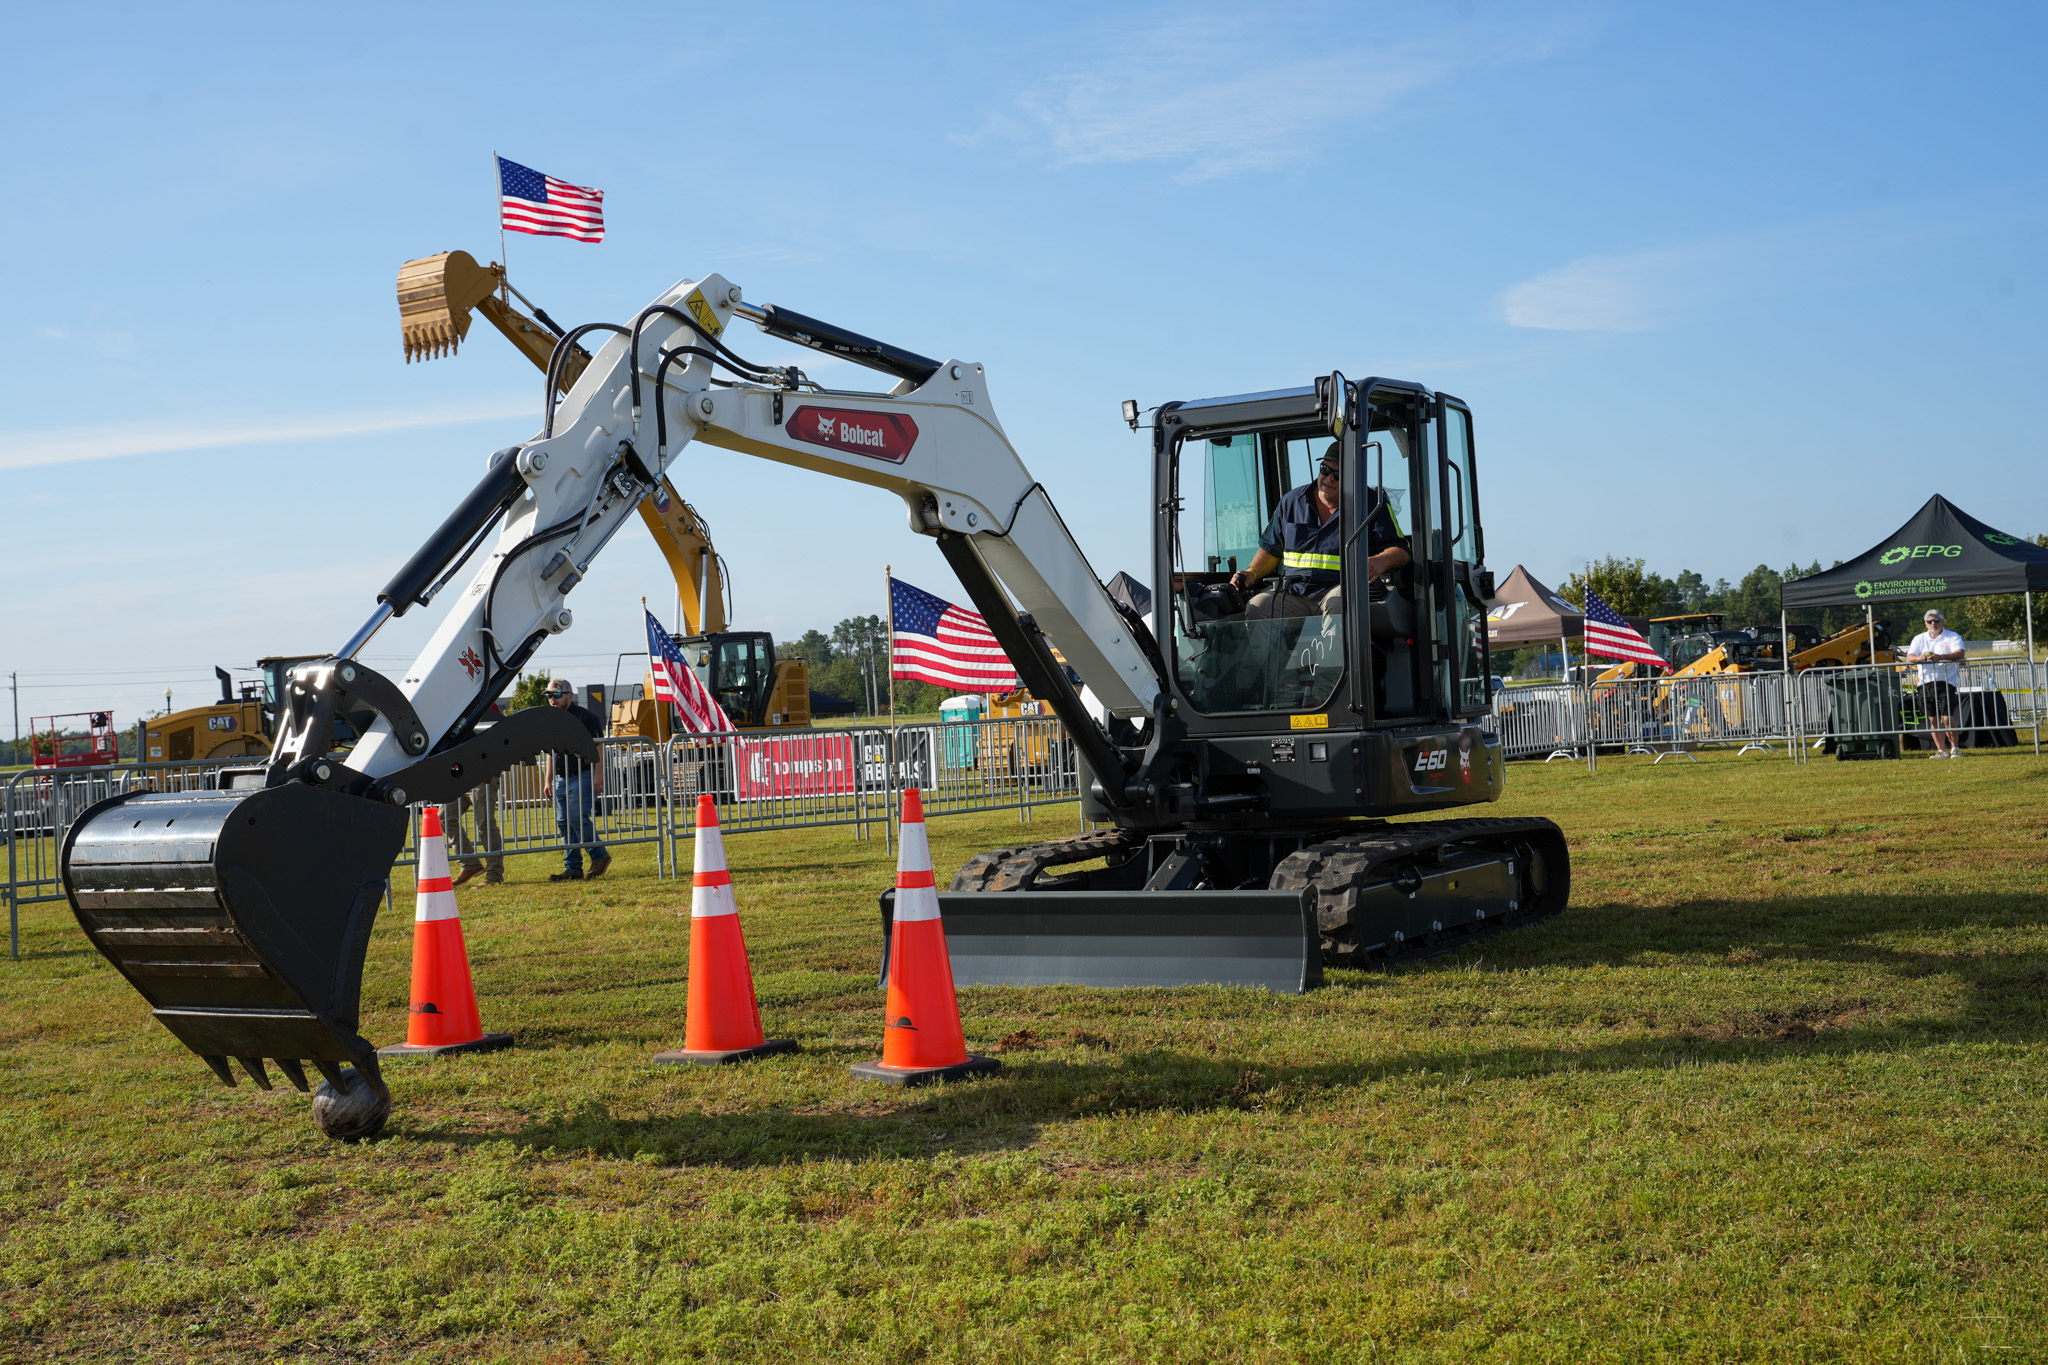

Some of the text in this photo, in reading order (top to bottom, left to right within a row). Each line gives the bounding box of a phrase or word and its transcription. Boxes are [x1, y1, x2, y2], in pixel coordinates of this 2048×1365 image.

[840, 422, 884, 447] Bobcat
[1911, 545, 1962, 558] EPG
[1874, 578, 1947, 590] ENVIRONMENTAL
[1874, 585, 1947, 596] PRODUCTS GROUP
[1487, 602, 1525, 621] AT
[1020, 701, 1040, 716] CAT
[208, 716, 231, 731] CAT
[1414, 749, 1448, 772] E60
